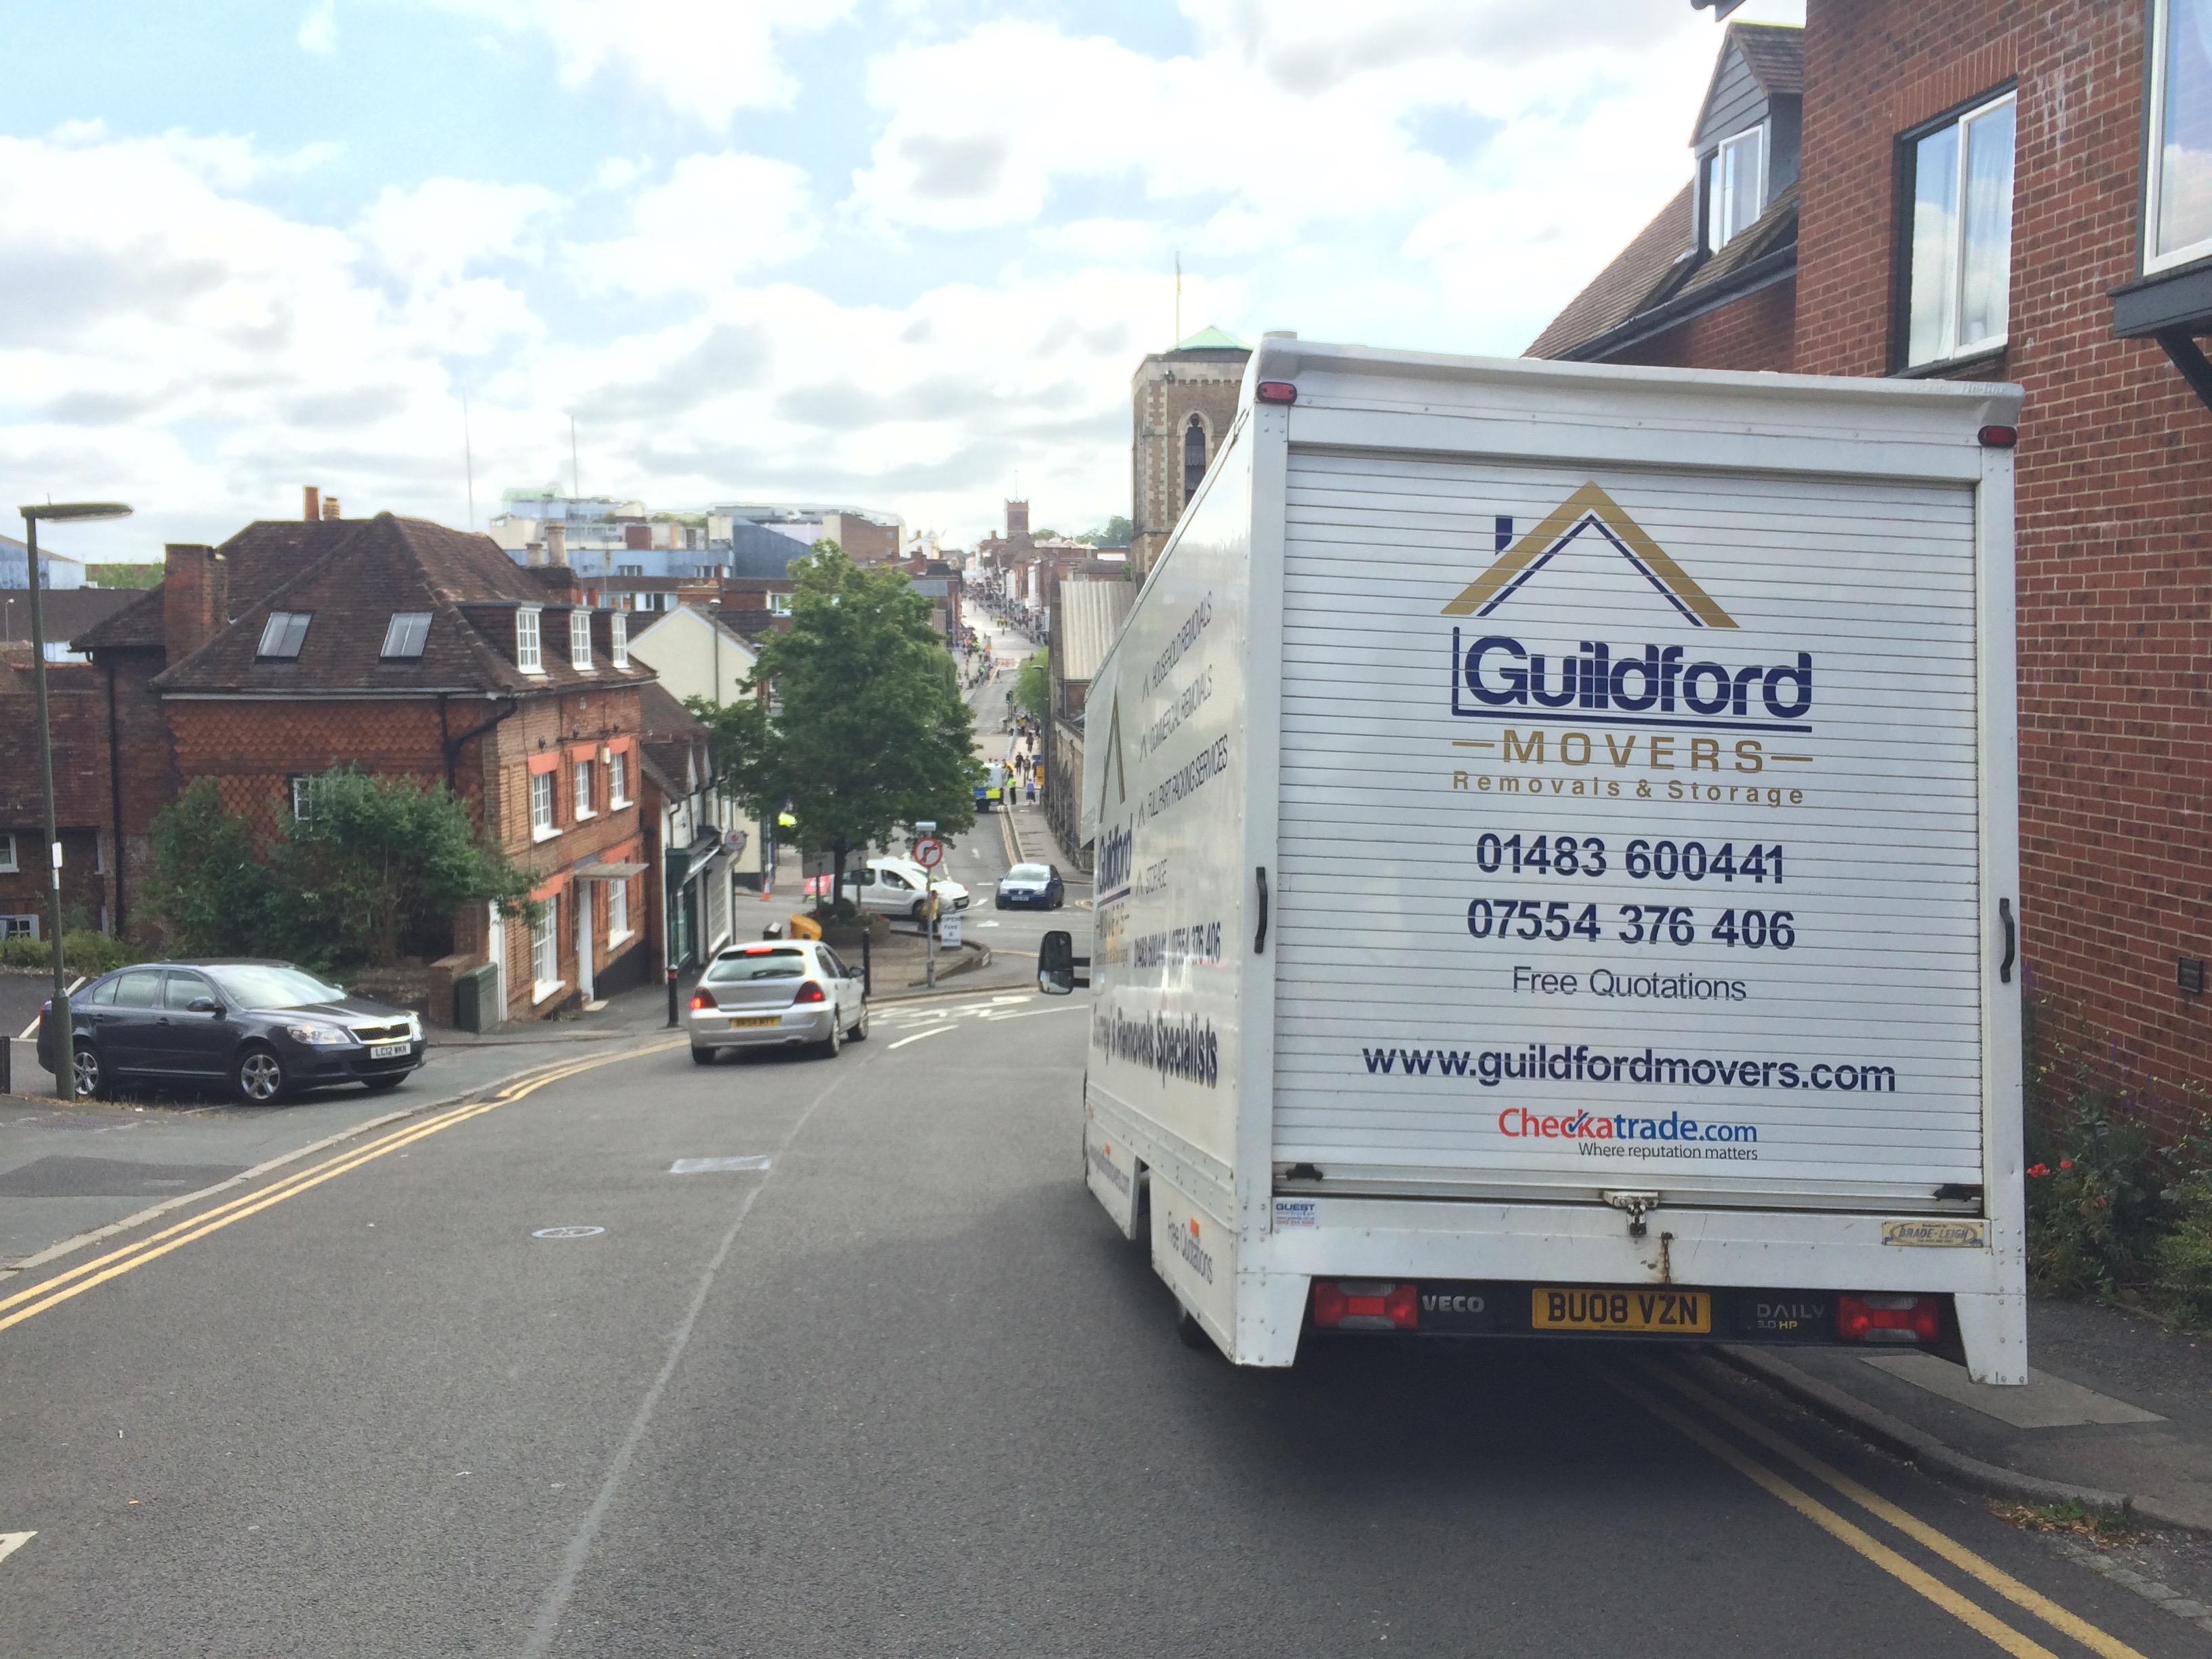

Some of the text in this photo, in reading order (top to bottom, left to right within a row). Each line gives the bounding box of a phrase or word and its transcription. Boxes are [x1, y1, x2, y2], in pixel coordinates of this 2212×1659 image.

[1153, 590, 1212, 690] HOUSEHOLD REMOVALS
[1181, 663, 1212, 722] REMOVALS
[1465, 635, 1812, 718] Guildford
[1172, 761, 1194, 803] PACKING
[1195, 733, 1227, 787] SERVICES
[1503, 729, 1763, 773] MOVERS
[1453, 771, 1804, 808] Removals & Storage
[1476, 833, 1784, 884] 01483 600441
[1205, 920, 1221, 964] 406
[1467, 898, 1795, 950] 07554 376 406
[1513, 966, 1747, 1001] Free Quotations
[1117, 1006, 1153, 1069] Removals
[1156, 1009, 1218, 1090] Specialists
[1362, 1044, 1896, 1092] www.guildfordmovers.com
[1498, 1108, 1757, 1142] Checkatrade.com
[1578, 1143, 1758, 1161] Where reputation matters
[1548, 1292, 1698, 1326] BU08 VZN
[1757, 1304, 1825, 1319] DAILY
